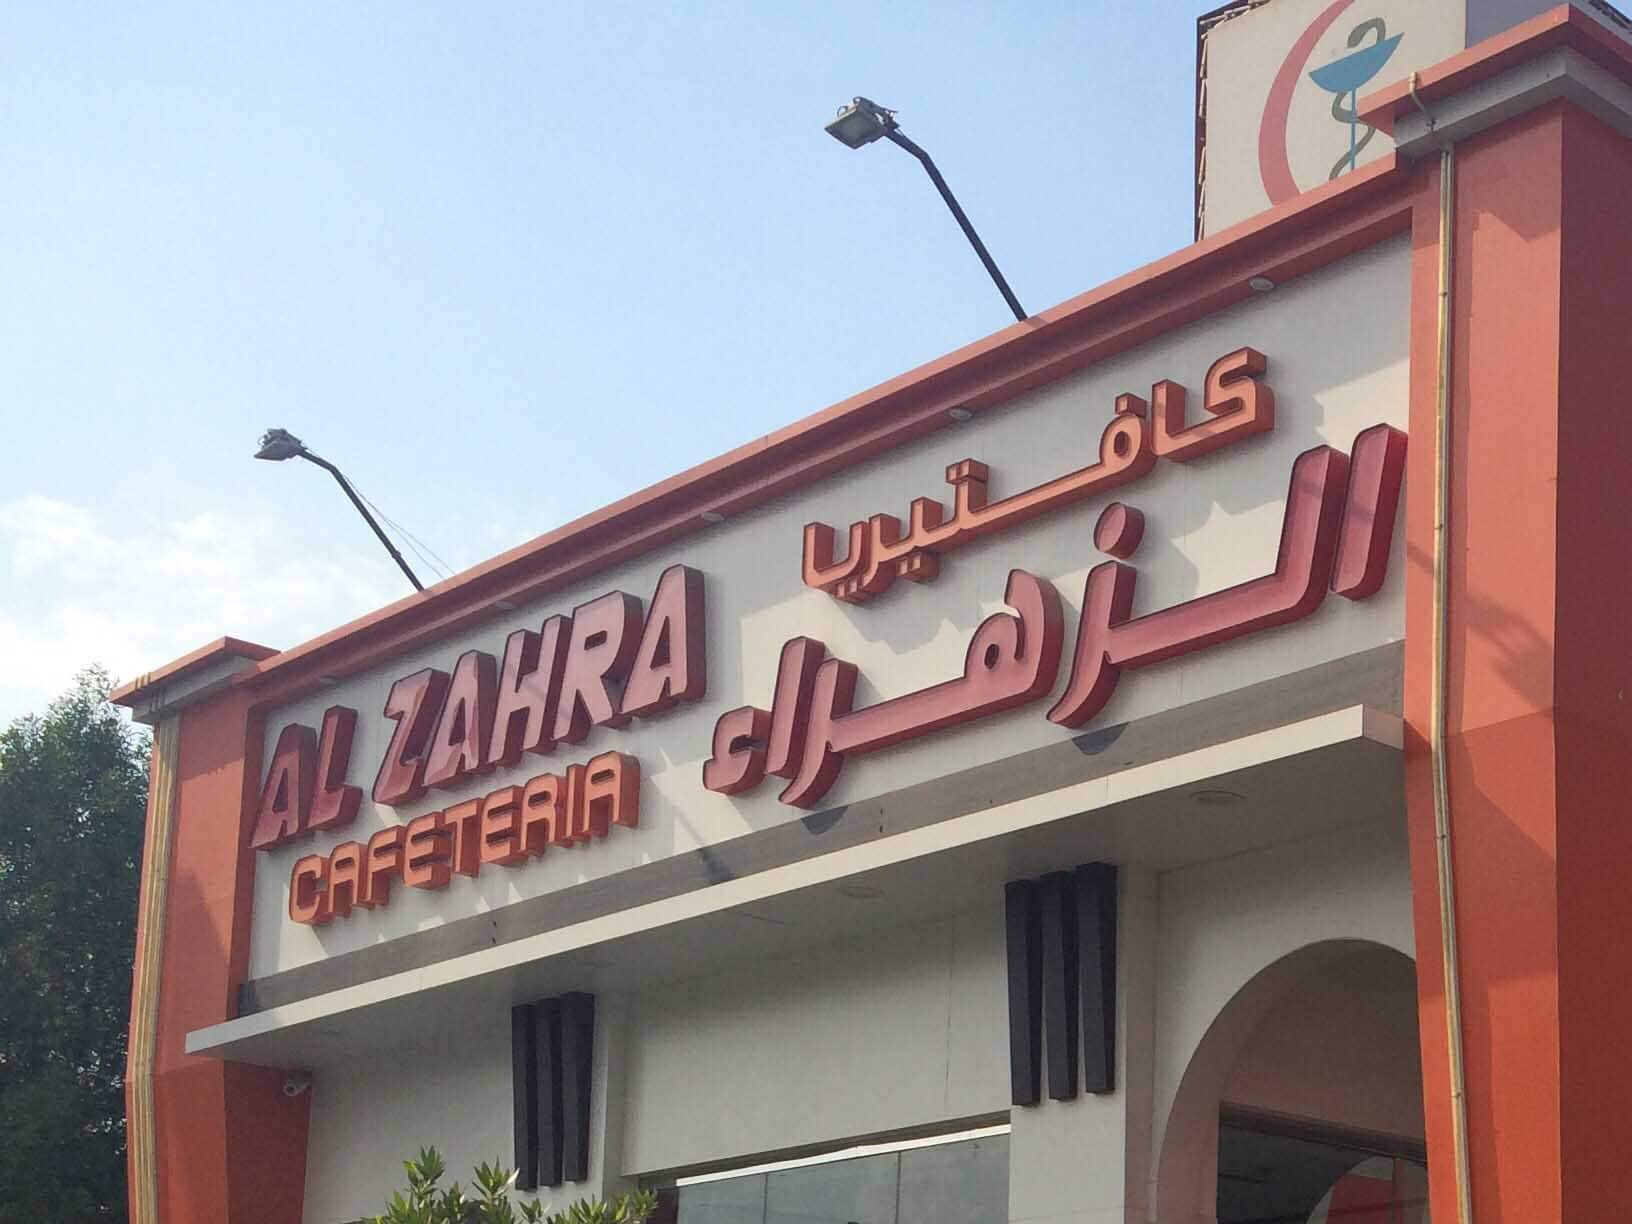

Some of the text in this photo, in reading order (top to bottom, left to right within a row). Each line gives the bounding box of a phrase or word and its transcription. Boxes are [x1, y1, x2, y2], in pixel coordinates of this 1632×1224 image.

[803, 346, 1275, 602] كافتيريا
[250, 563, 706, 852] AL ZAHRA
[703, 422, 1408, 809] الزهراء
[289, 750, 640, 925] CAFETERIA
